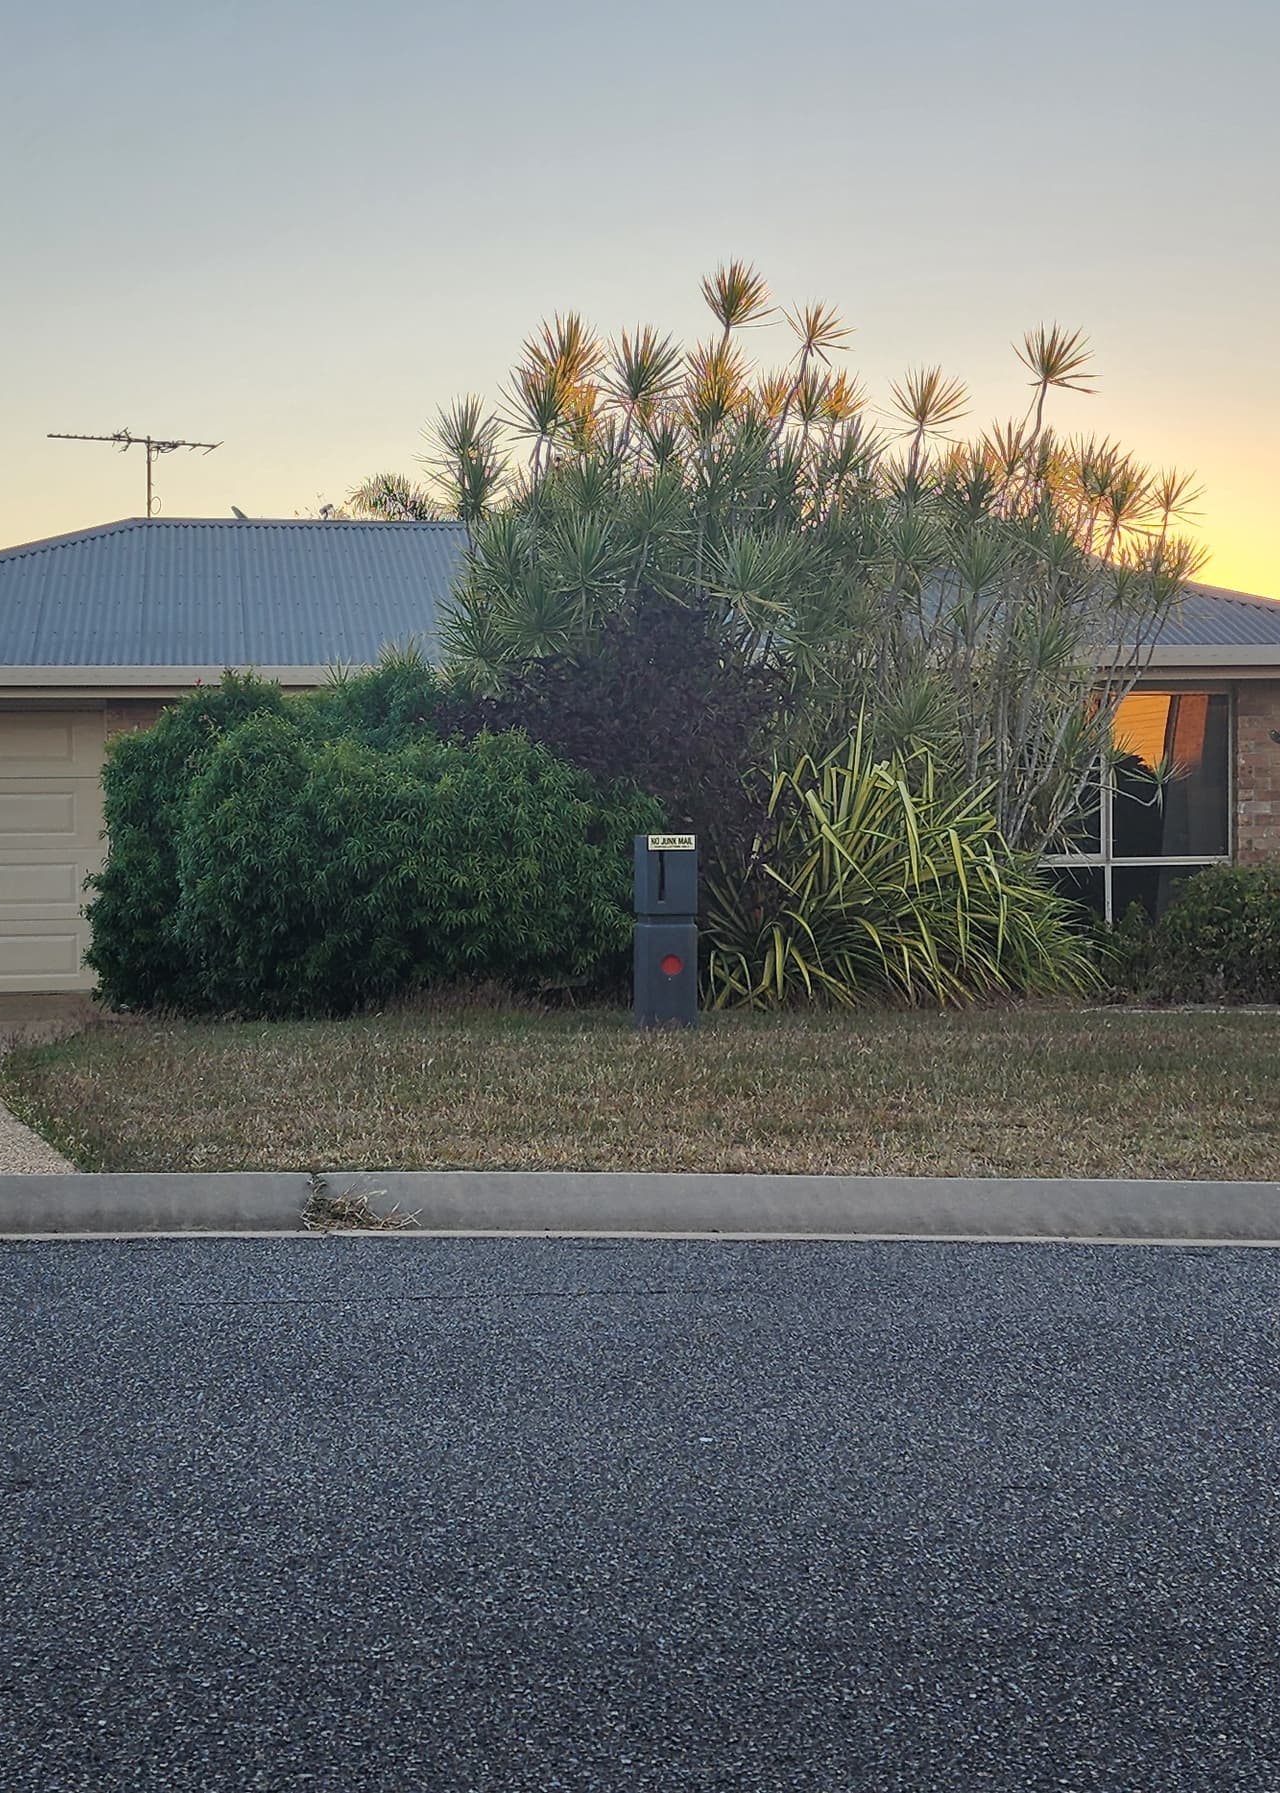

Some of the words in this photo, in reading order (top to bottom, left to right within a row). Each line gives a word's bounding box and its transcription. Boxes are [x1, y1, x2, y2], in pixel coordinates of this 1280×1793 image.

[650, 837, 660, 845] NO
[661, 837, 677, 845] JUNK
[678, 837, 693, 845] MAIL
